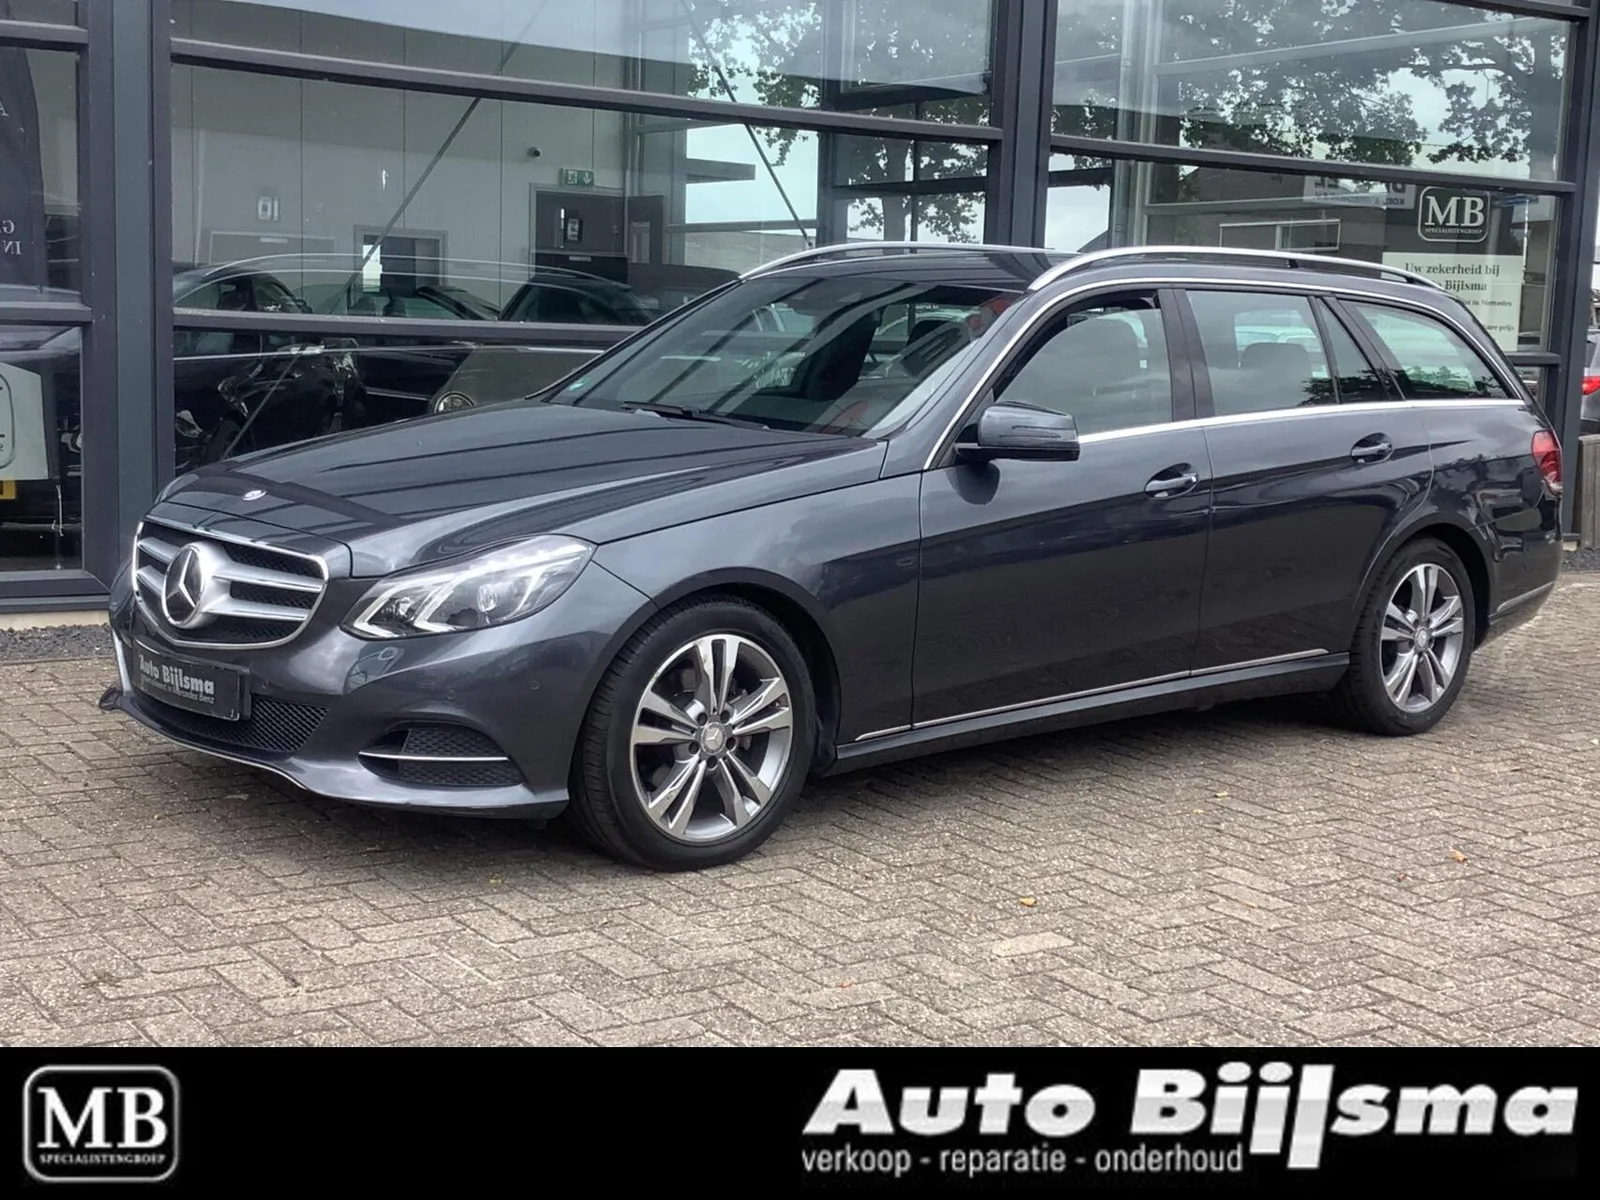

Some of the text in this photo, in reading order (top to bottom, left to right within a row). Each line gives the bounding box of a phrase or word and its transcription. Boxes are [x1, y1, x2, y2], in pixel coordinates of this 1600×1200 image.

[1424, 196, 1485, 226] MB
[1405, 262, 1500, 277] Uw zekerheid bij
[139, 655, 160, 679] Auto
[162, 664, 215, 694] Bijlsma
